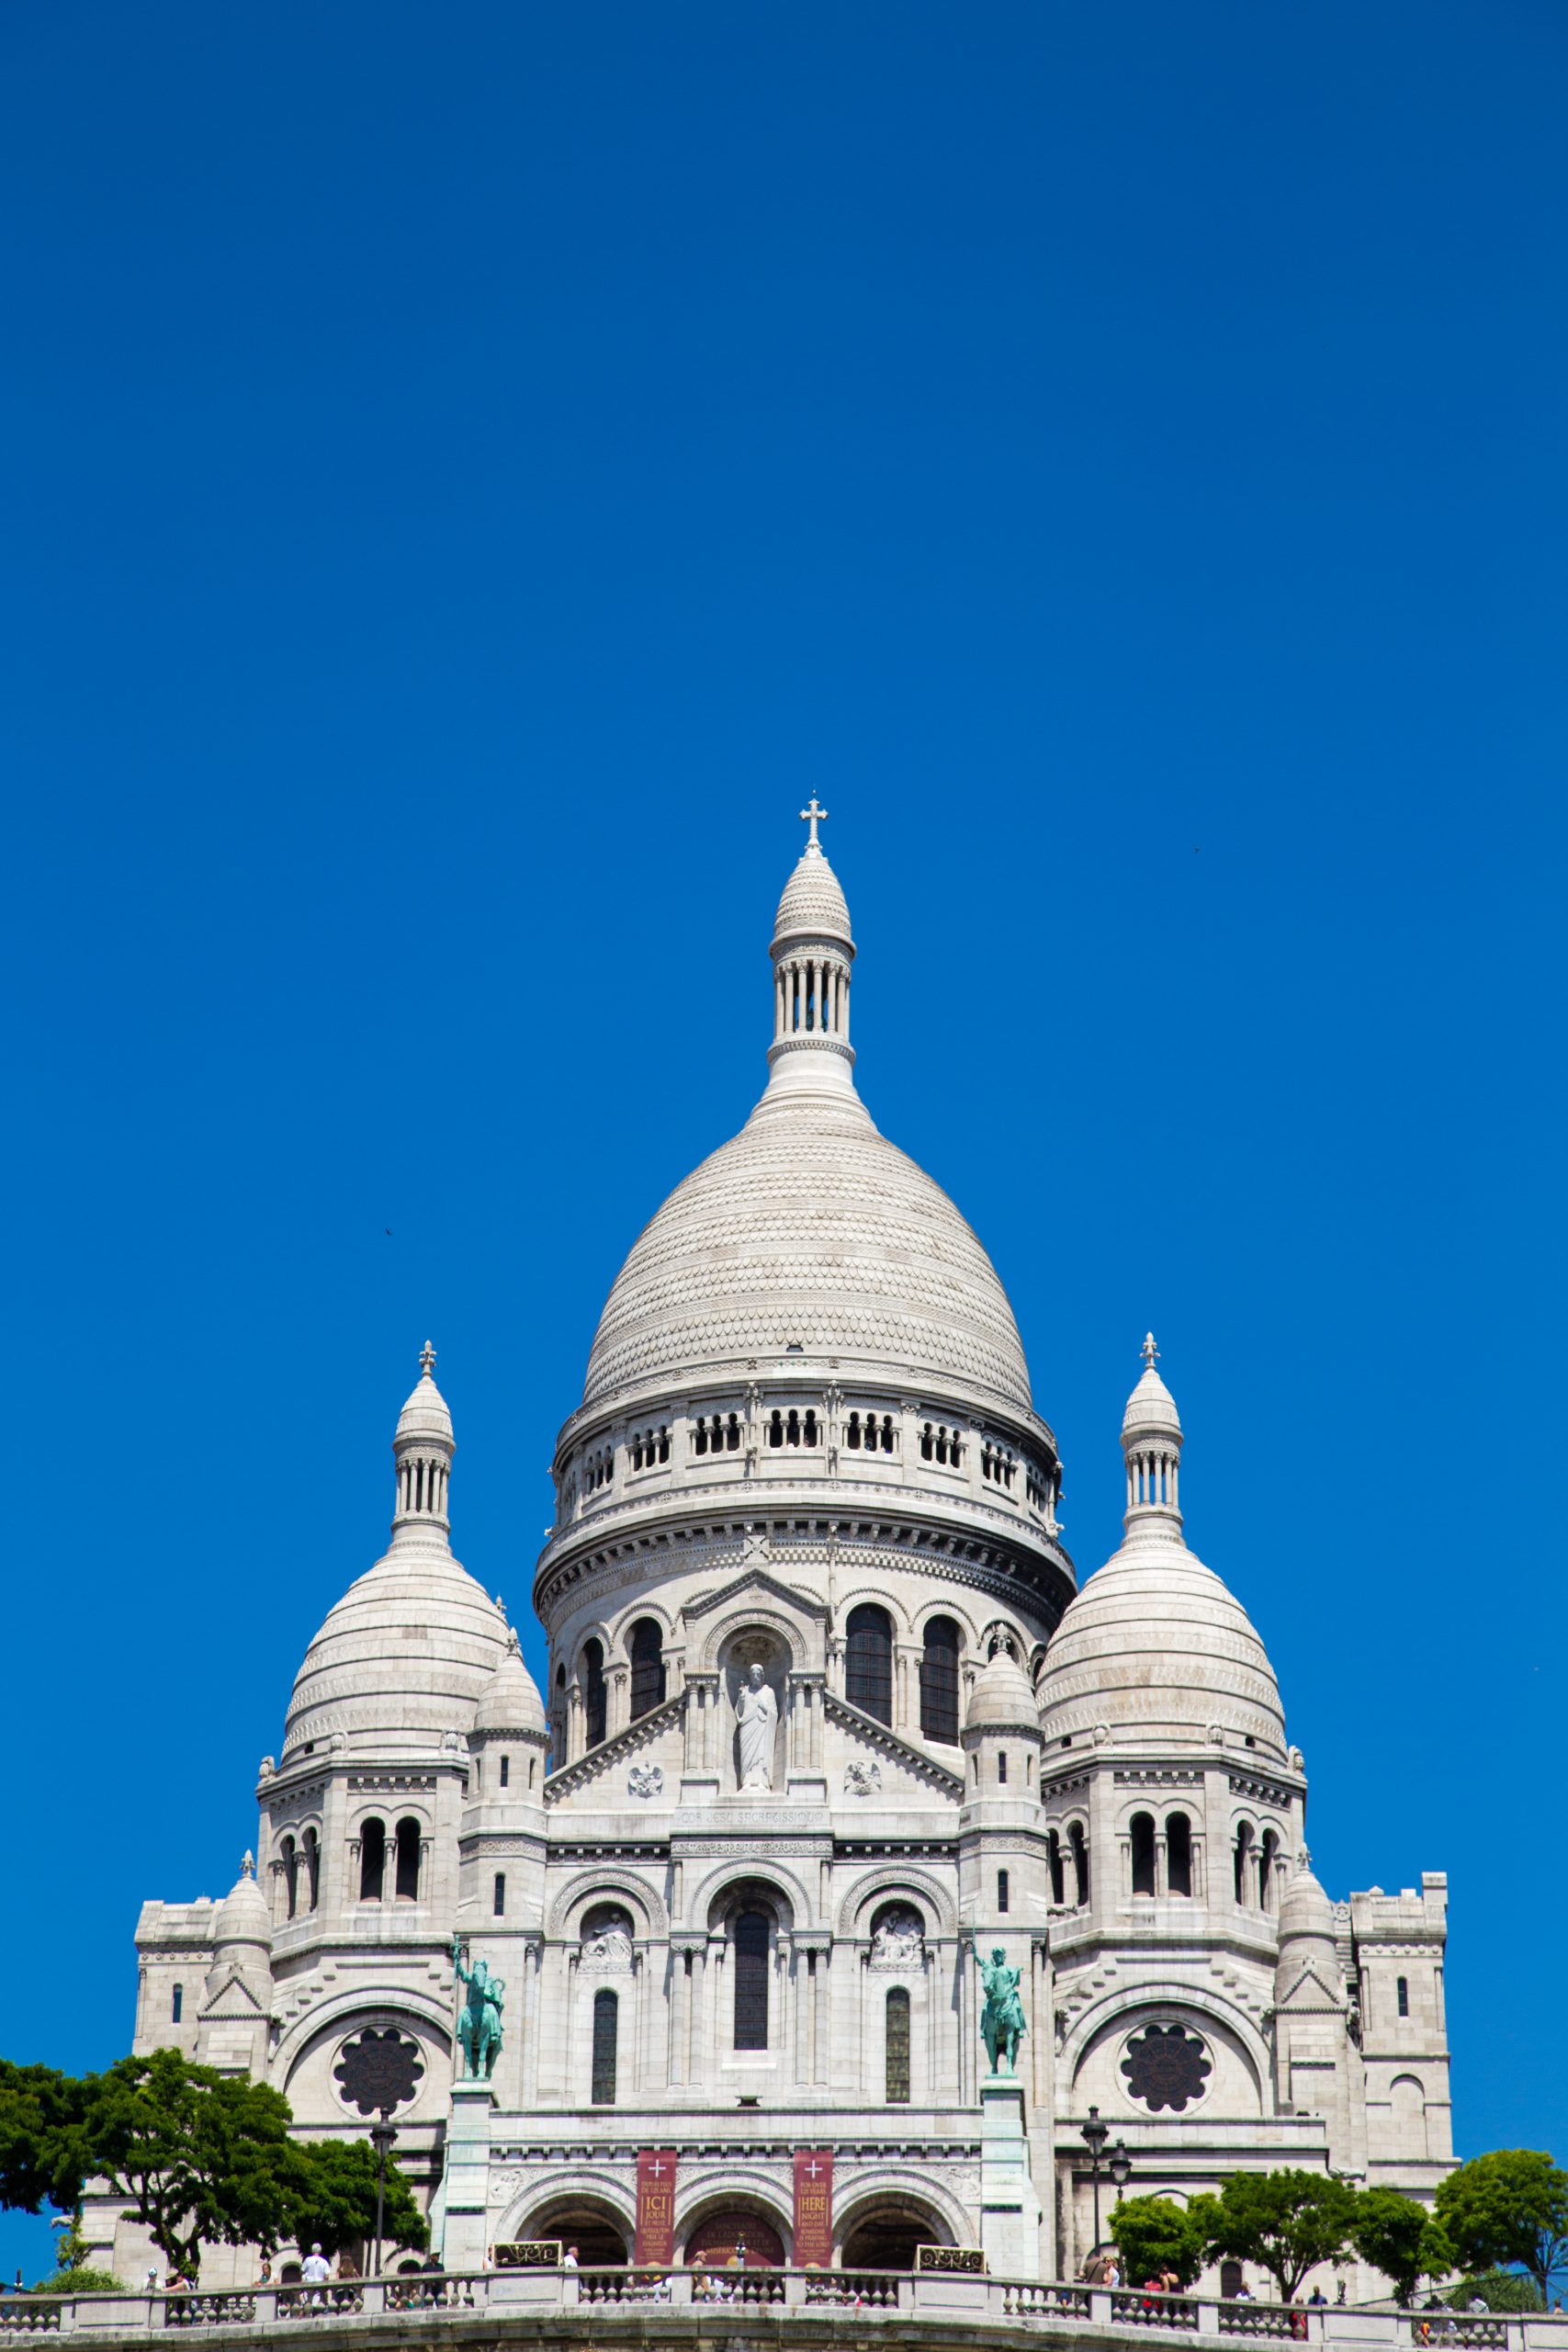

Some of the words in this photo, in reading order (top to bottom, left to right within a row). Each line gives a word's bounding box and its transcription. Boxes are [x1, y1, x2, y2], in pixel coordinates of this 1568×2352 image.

[646, 2196, 666, 2211] ICI
[801, 2197, 826, 2211] HERE
[646, 2211, 666, 2220] JOUR
[801, 2211, 825, 2220] NIGHT
